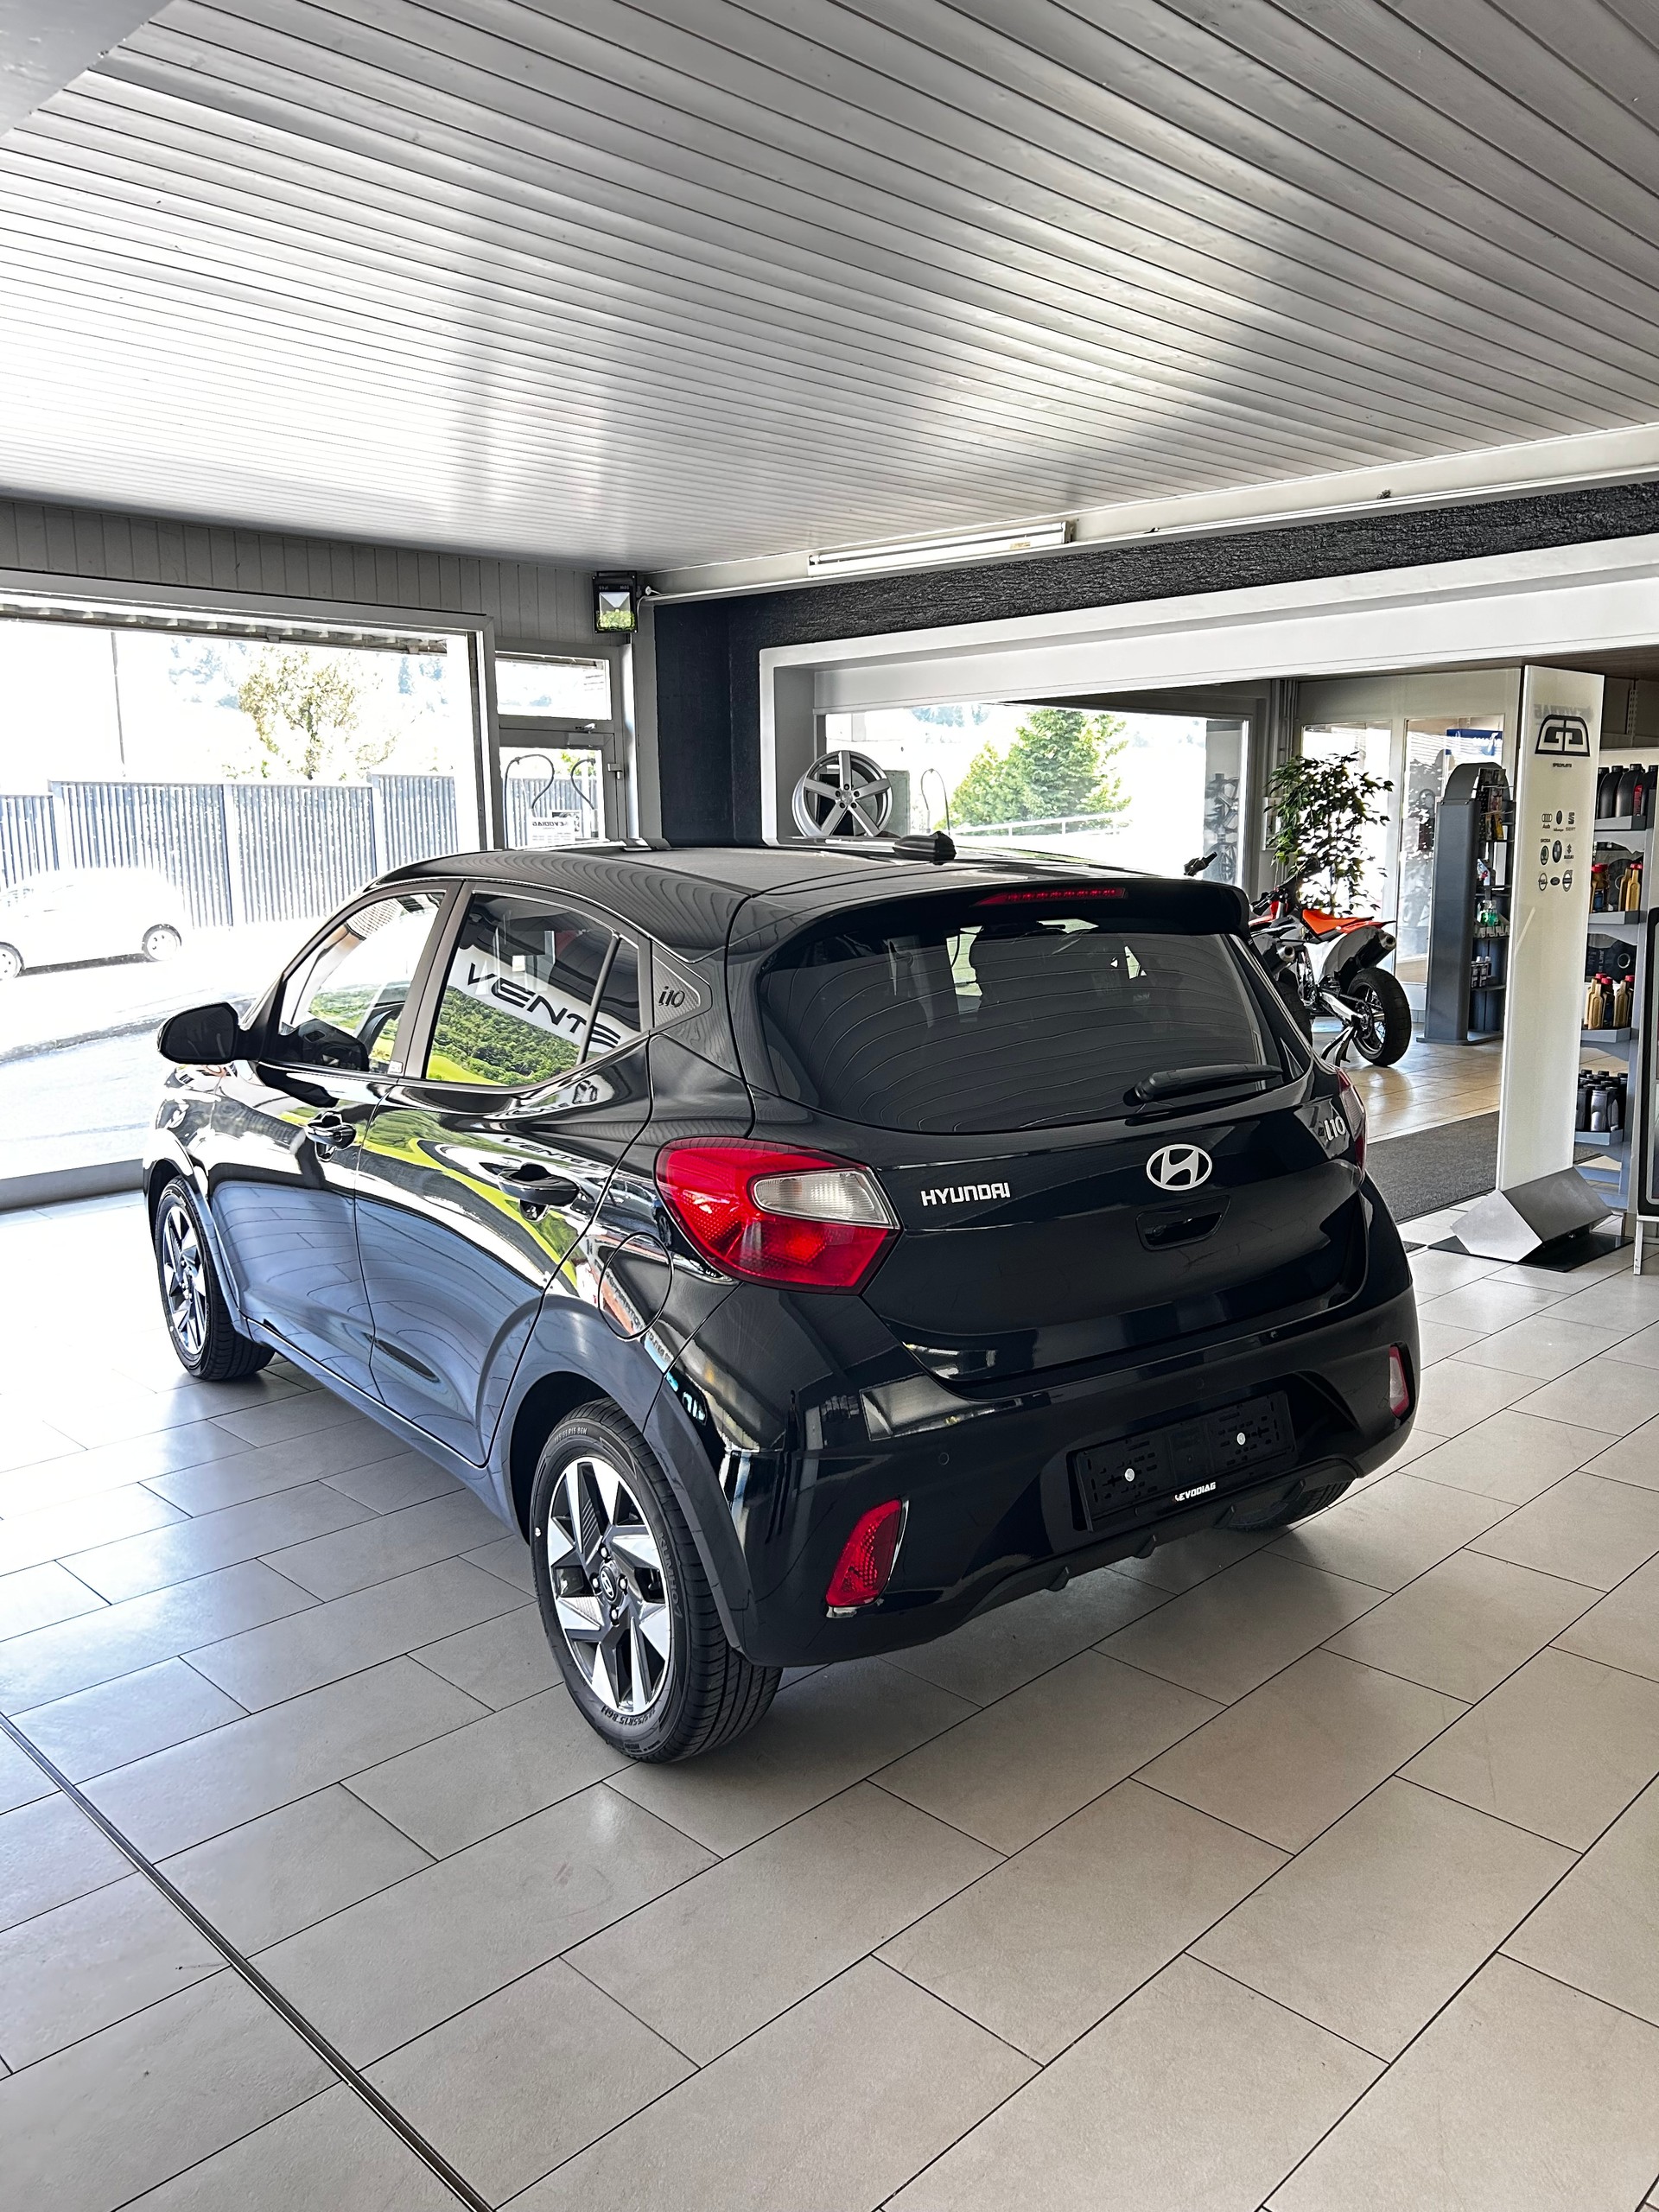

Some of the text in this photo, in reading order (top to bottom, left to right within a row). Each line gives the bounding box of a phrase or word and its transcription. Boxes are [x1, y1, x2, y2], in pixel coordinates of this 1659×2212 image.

[658, 986, 685, 1008] i10
[920, 1182, 1011, 1206] HYUNDAI
[1179, 1481, 1217, 1502] EVODIAG
